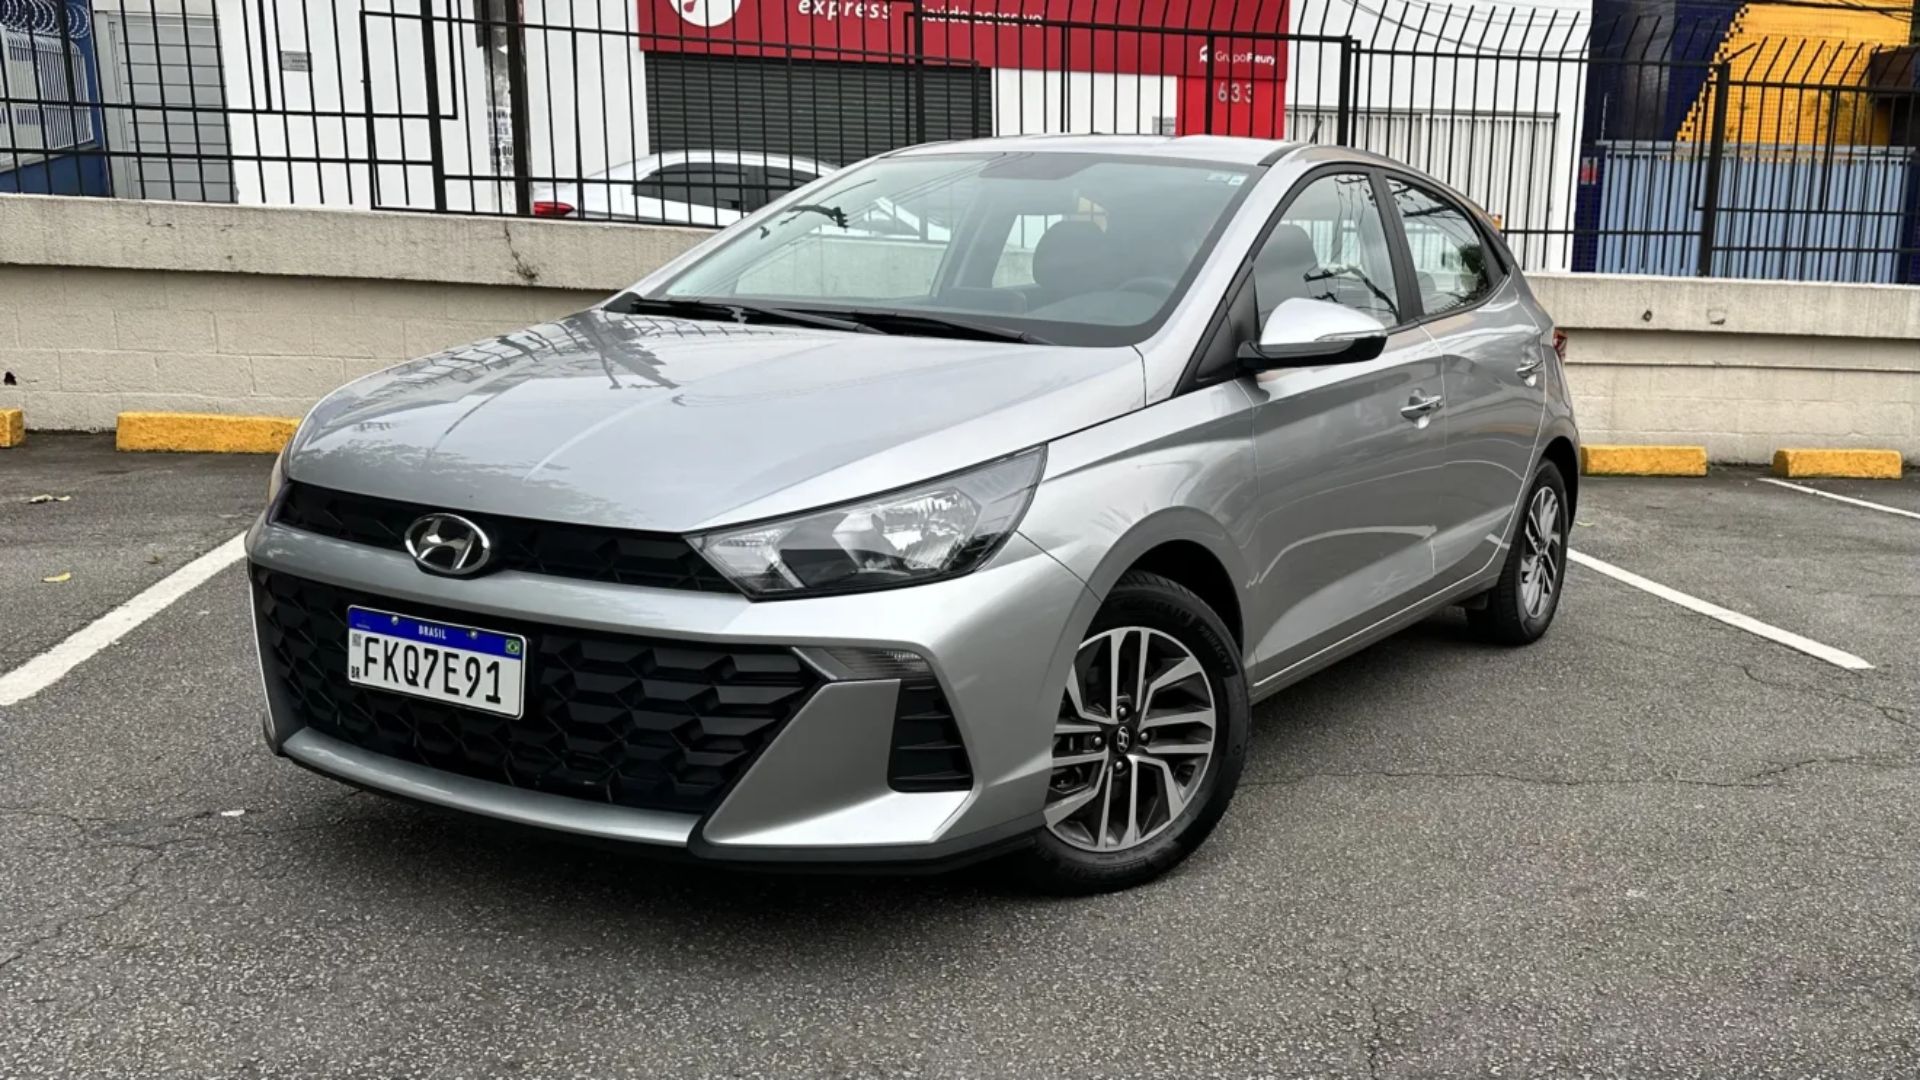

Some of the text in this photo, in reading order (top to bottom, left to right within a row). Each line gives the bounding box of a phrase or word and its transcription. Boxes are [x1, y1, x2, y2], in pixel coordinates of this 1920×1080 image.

[798, 0, 892, 21] express
[921, 5, 1046, 27] aúde acessve
[1215, 50, 1275, 66] GrpoFeury
[1218, 81, 1253, 103] 633
[418, 625, 447, 641] BRASIL
[364, 636, 501, 705] FKQ7E91
